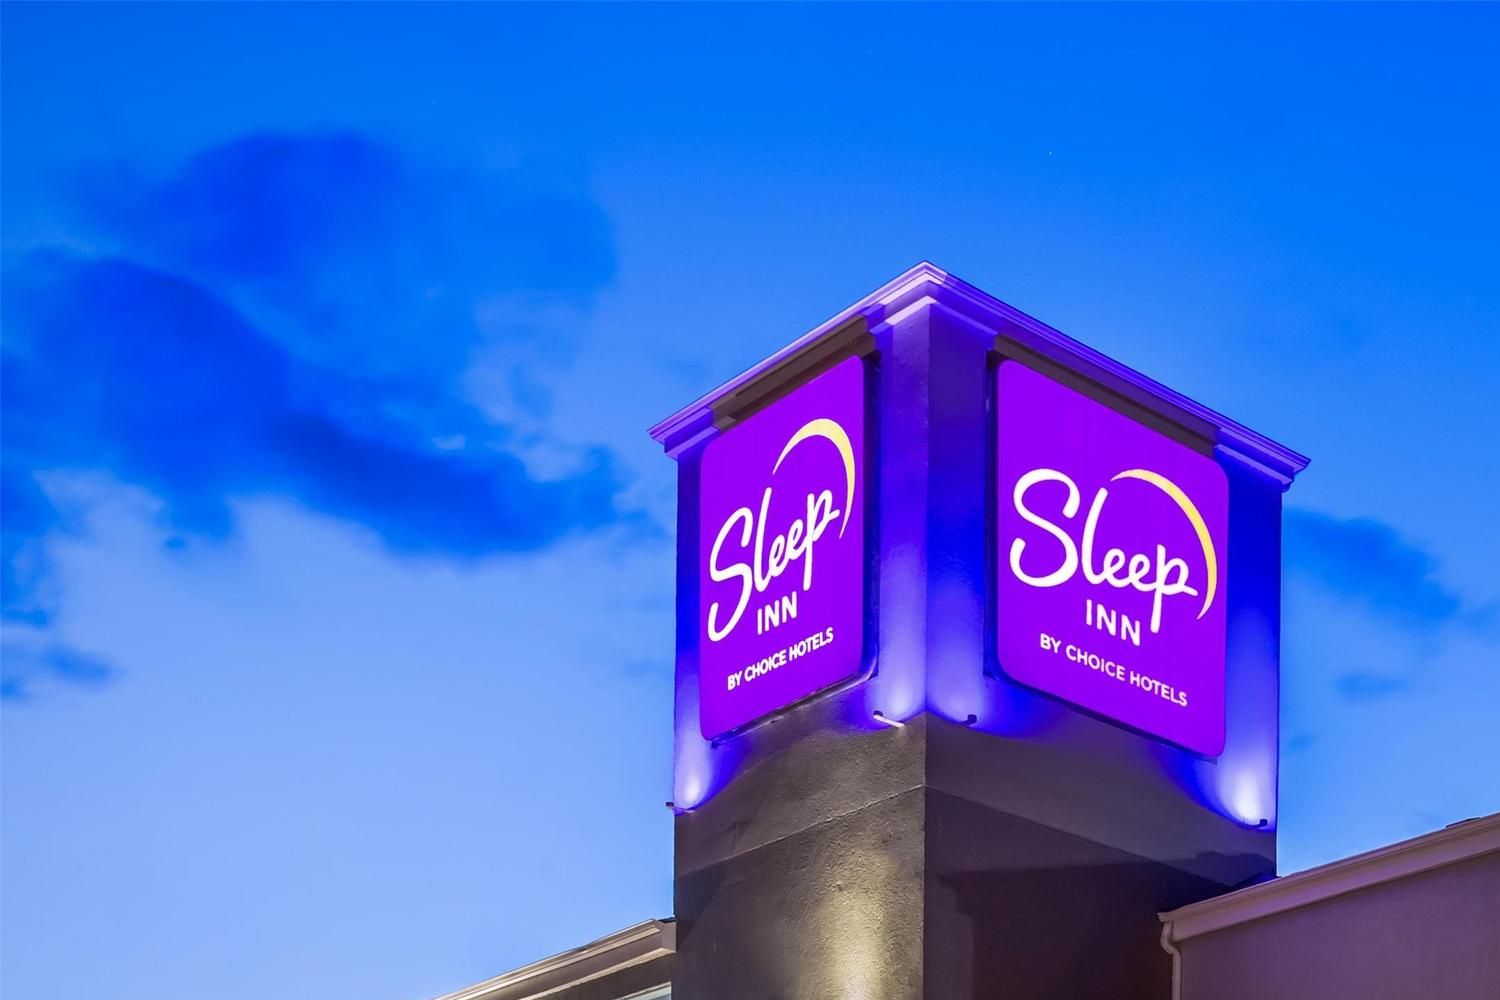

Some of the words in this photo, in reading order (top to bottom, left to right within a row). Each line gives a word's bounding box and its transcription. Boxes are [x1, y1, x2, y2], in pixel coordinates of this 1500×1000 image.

[708, 487, 840, 641] Sleep
[1010, 469, 1198, 633] Sleep
[757, 591, 798, 635] INN
[1086, 599, 1141, 646] INN
[727, 670, 743, 691] BY
[743, 649, 787, 683] CHOICE
[788, 626, 834, 662] HOTELS
[1040, 632, 1062, 654] BY
[1065, 644, 1125, 682] CHOICE
[1129, 671, 1188, 707] HOTELS
